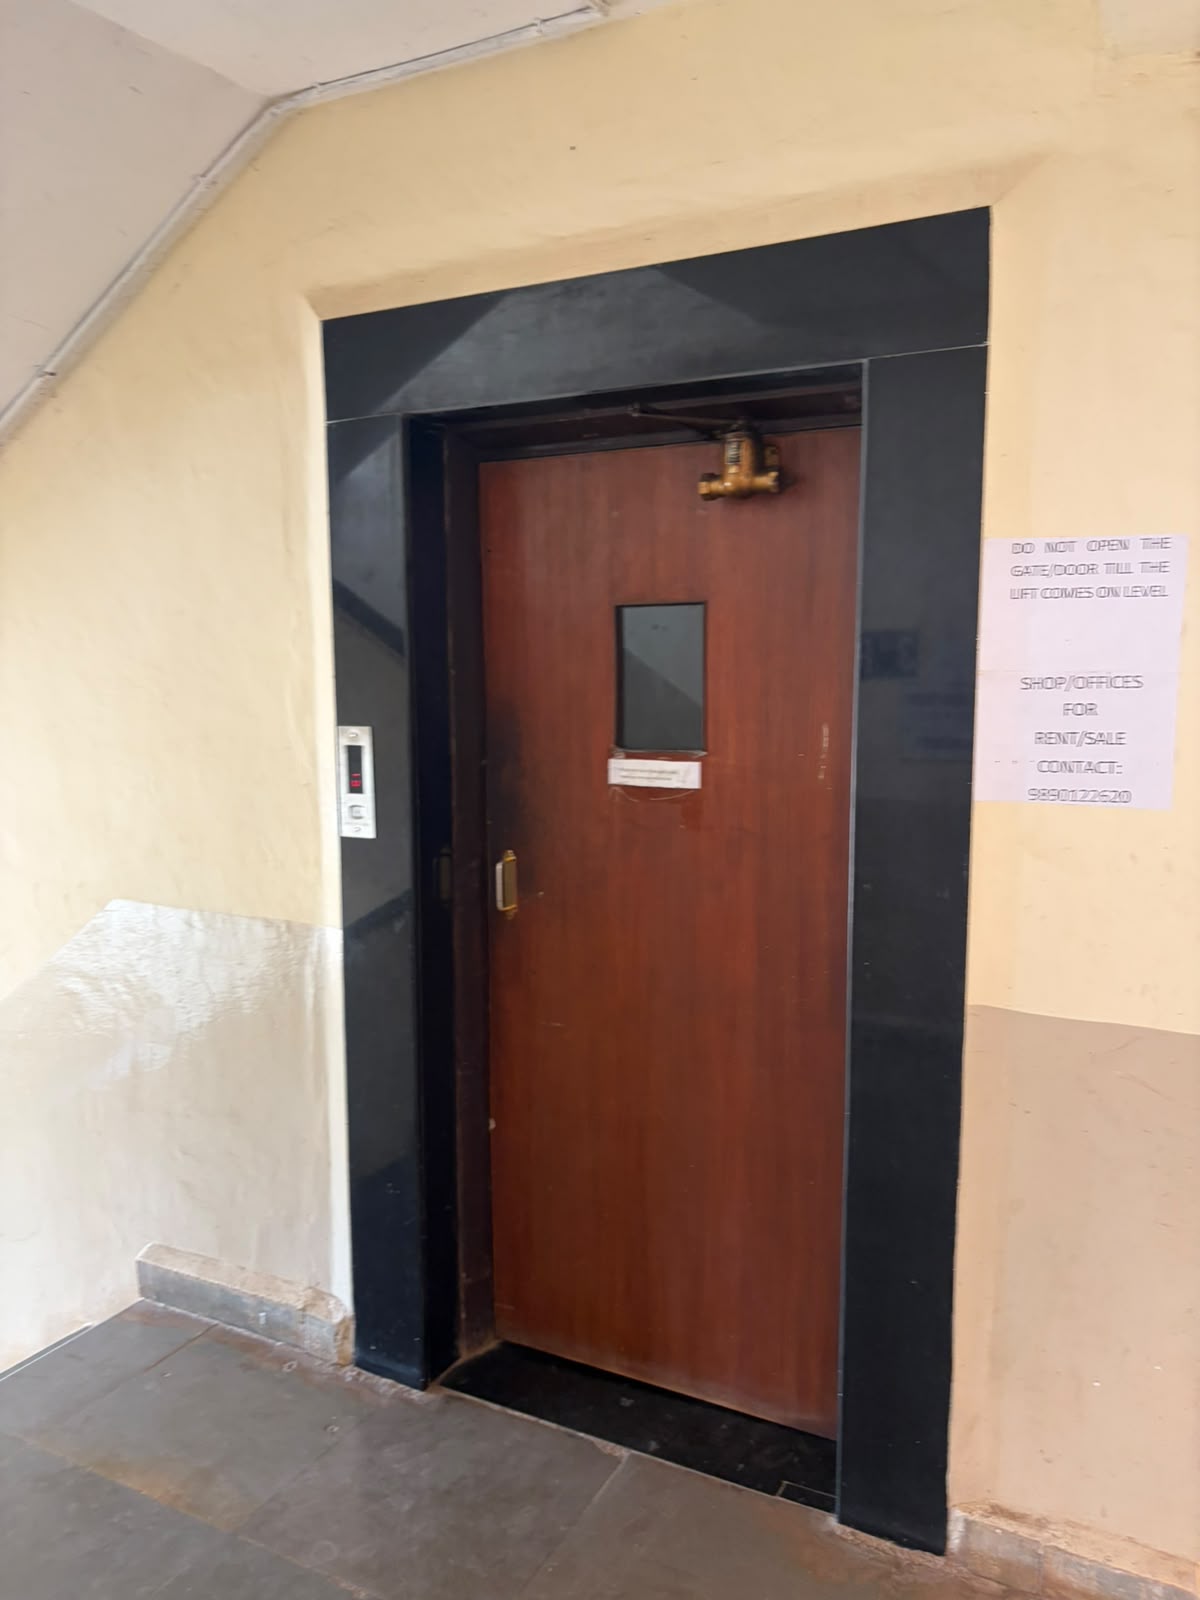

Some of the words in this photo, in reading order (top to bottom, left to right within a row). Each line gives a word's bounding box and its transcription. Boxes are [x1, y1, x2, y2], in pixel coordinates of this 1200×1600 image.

[1012, 542, 1035, 554] DO
[1044, 541, 1077, 553] NOT
[1086, 539, 1129, 551] OPEN
[1140, 537, 1172, 550] THE
[1010, 564, 1099, 578] GATE/DOOR
[1103, 562, 1134, 575] TILL
[1139, 561, 1170, 573] THE
[1010, 587, 1039, 600] LIFT
[1040, 586, 1094, 599] COMES
[1095, 586, 1121, 598] ON
[1123, 585, 1168, 598] LEVEL
[1020, 675, 1144, 691] SHOP/OFFICES
[1063, 702, 1098, 716] FOR
[1034, 730, 1127, 747] RENT/SALE
